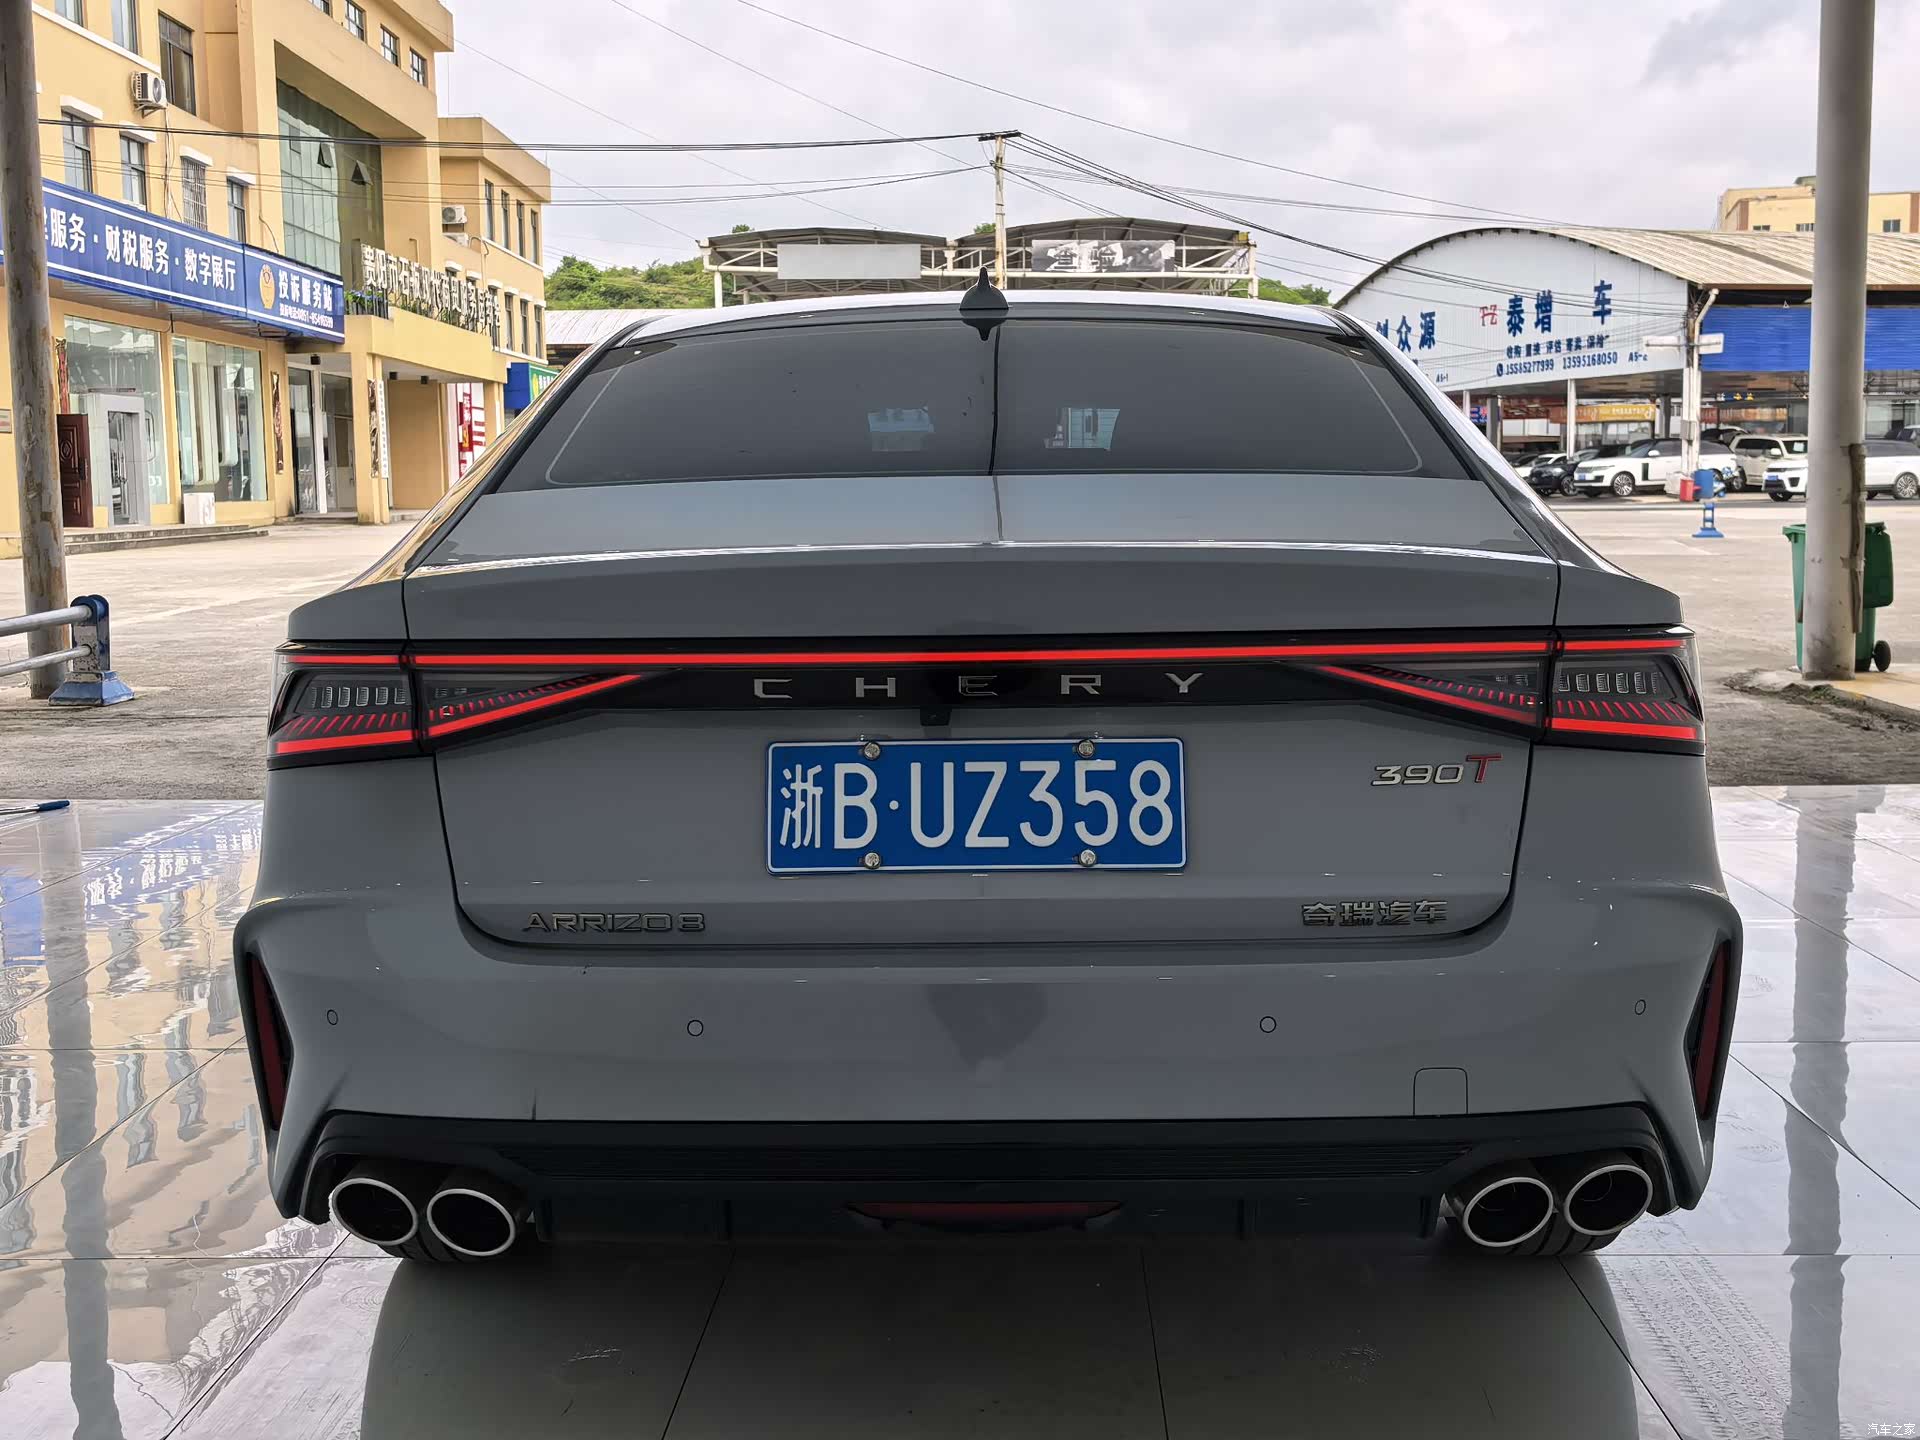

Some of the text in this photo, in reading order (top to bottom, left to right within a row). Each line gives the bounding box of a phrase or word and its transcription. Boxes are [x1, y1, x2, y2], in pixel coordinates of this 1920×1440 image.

[43, 206, 236, 292] 服务·财税服务·数字展厅
[278, 269, 334, 312] 投诉服务站
[1562, 351, 1618, 369] 13595168050
[753, 673, 1205, 699] CHERY
[1371, 752, 1503, 786] 390T
[779, 759, 1174, 850] 浙B·UZ358
[1301, 898, 1448, 926] 奇瑞汽车
